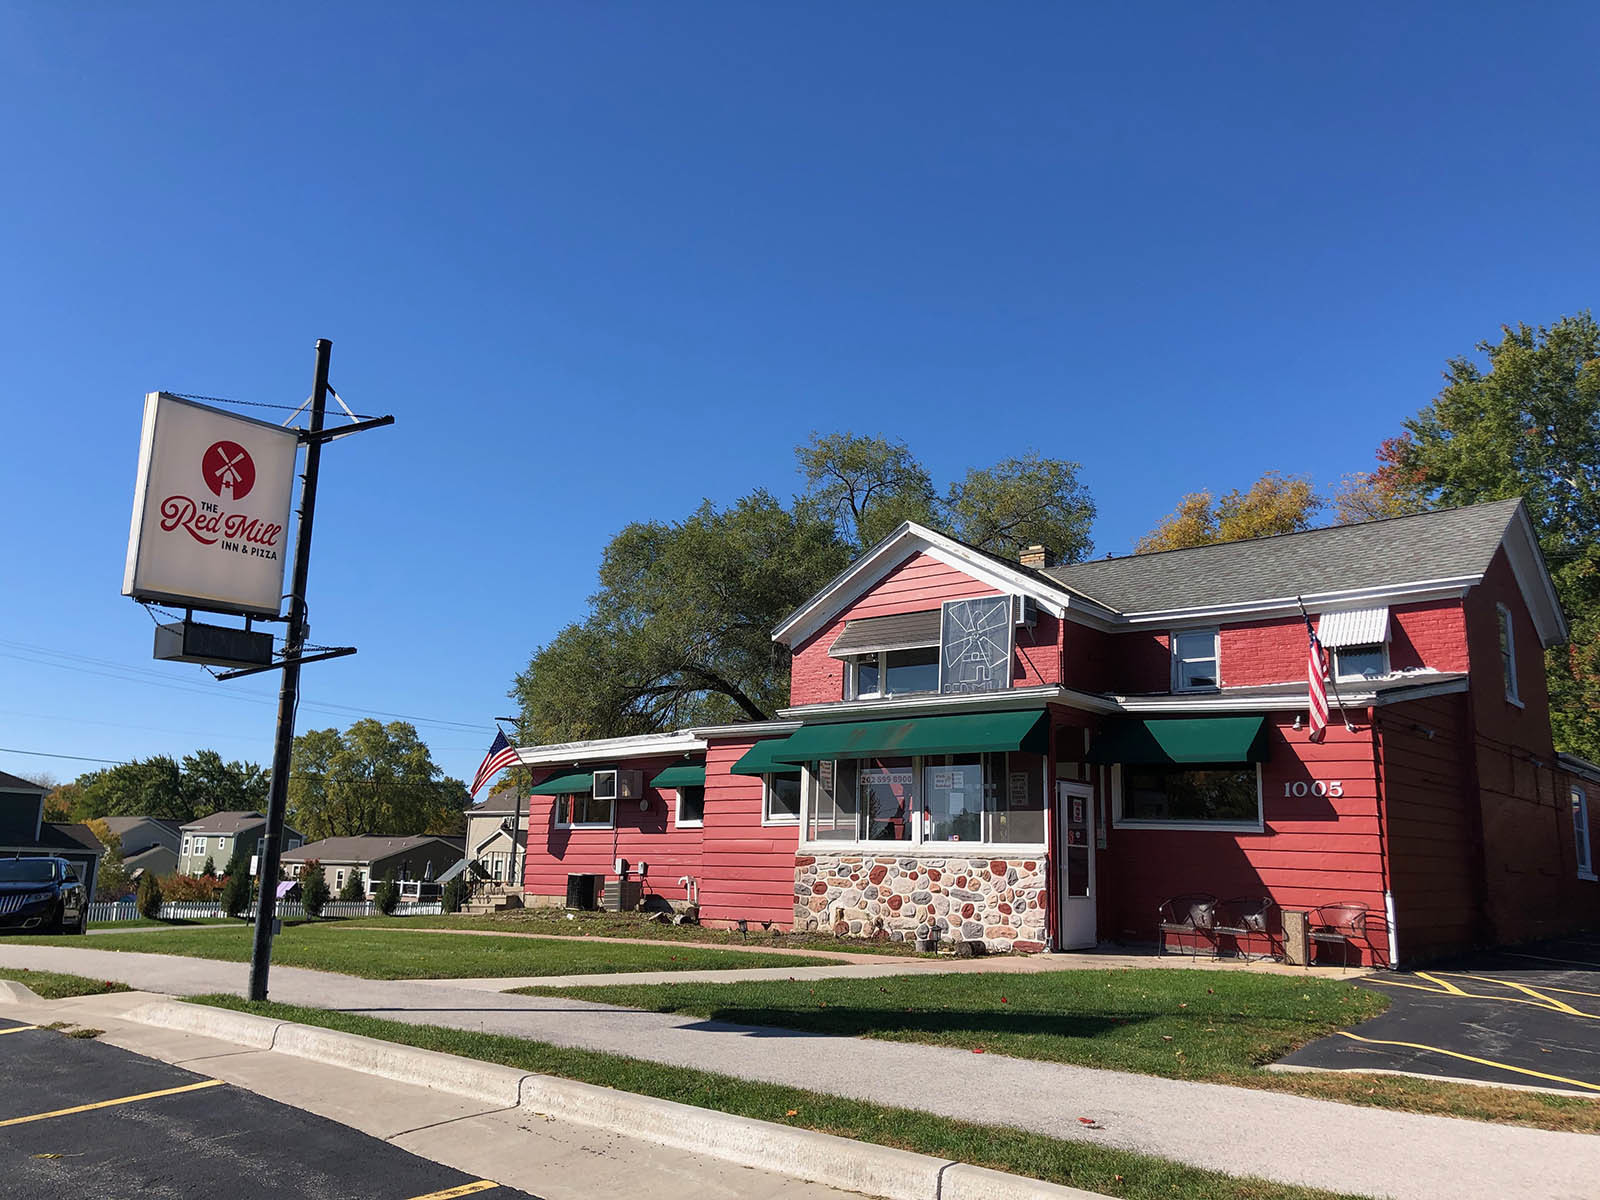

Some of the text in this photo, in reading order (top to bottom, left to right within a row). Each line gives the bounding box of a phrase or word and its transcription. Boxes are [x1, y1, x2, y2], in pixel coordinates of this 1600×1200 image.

[201, 501, 218, 513] THE
[160, 495, 282, 546] Red Mill
[221, 540, 277, 560] INN & PIZZA
[1284, 780, 1344, 798] 1005
